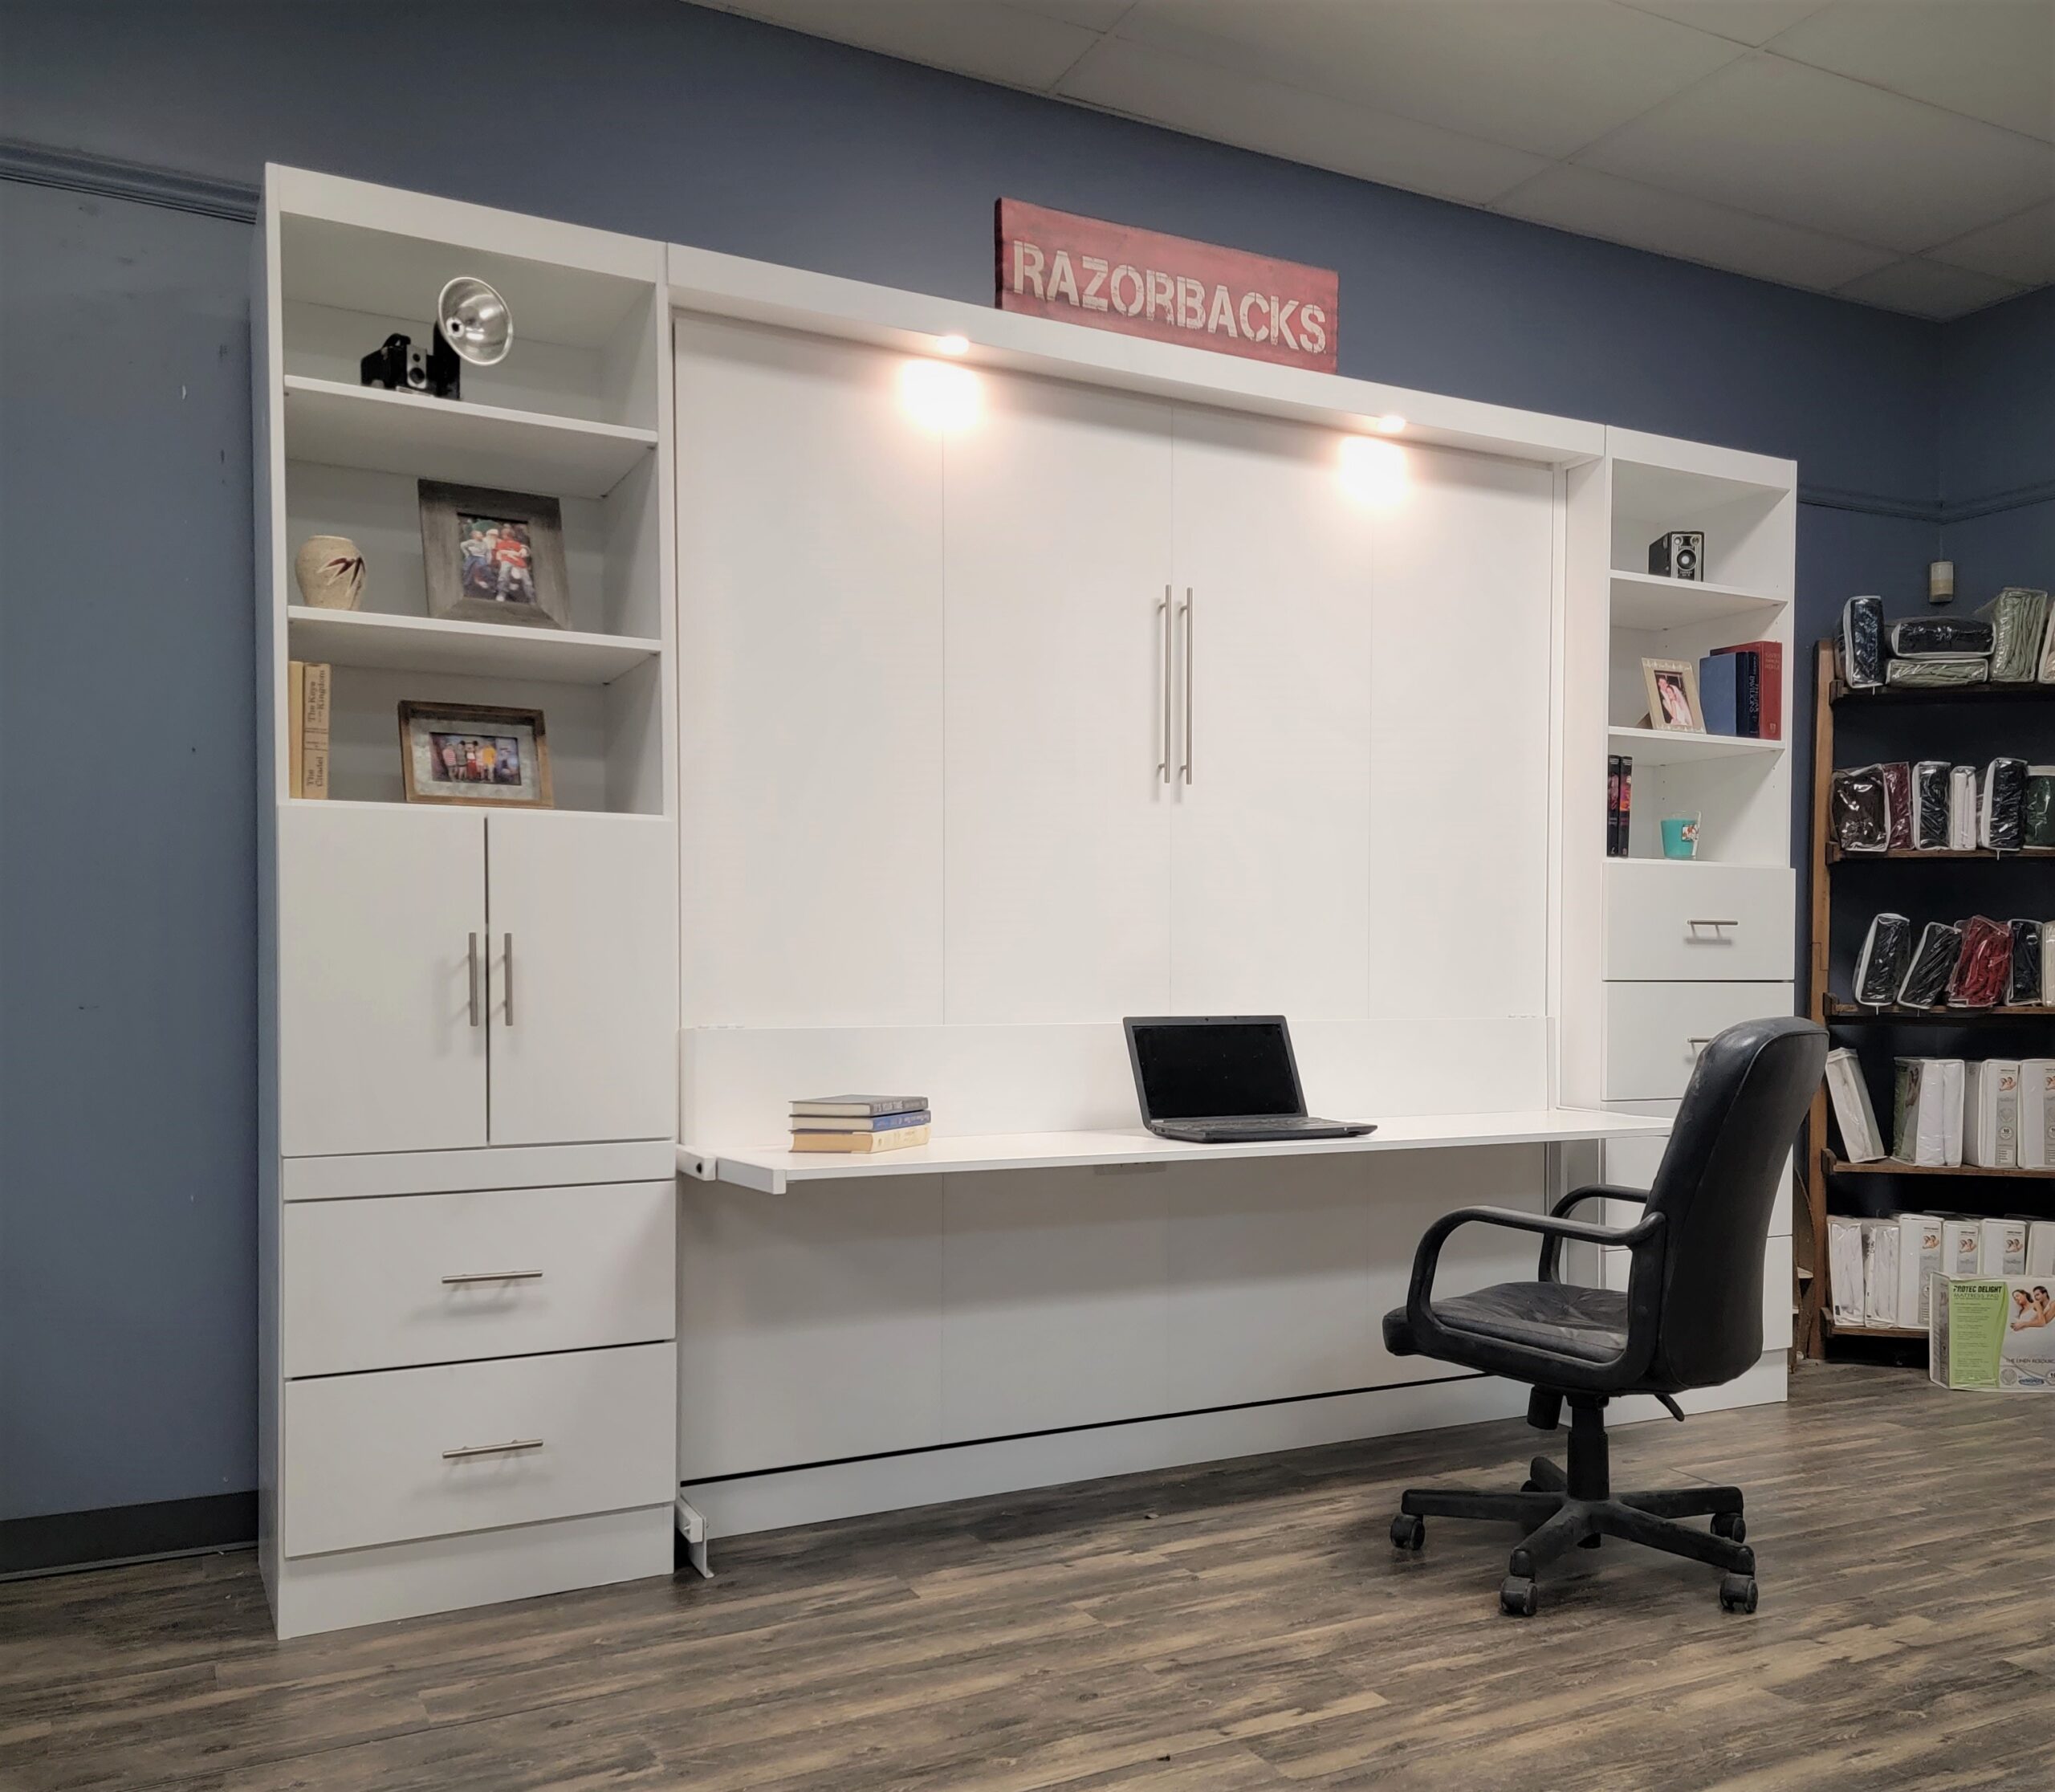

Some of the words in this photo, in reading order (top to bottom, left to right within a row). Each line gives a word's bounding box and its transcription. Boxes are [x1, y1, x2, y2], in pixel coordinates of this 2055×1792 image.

[1014, 240, 1326, 354] RAZORBACKS
[317, 670, 327, 710] Kingdom
[307, 703, 315, 723] The
[315, 756, 324, 787] Citadel
